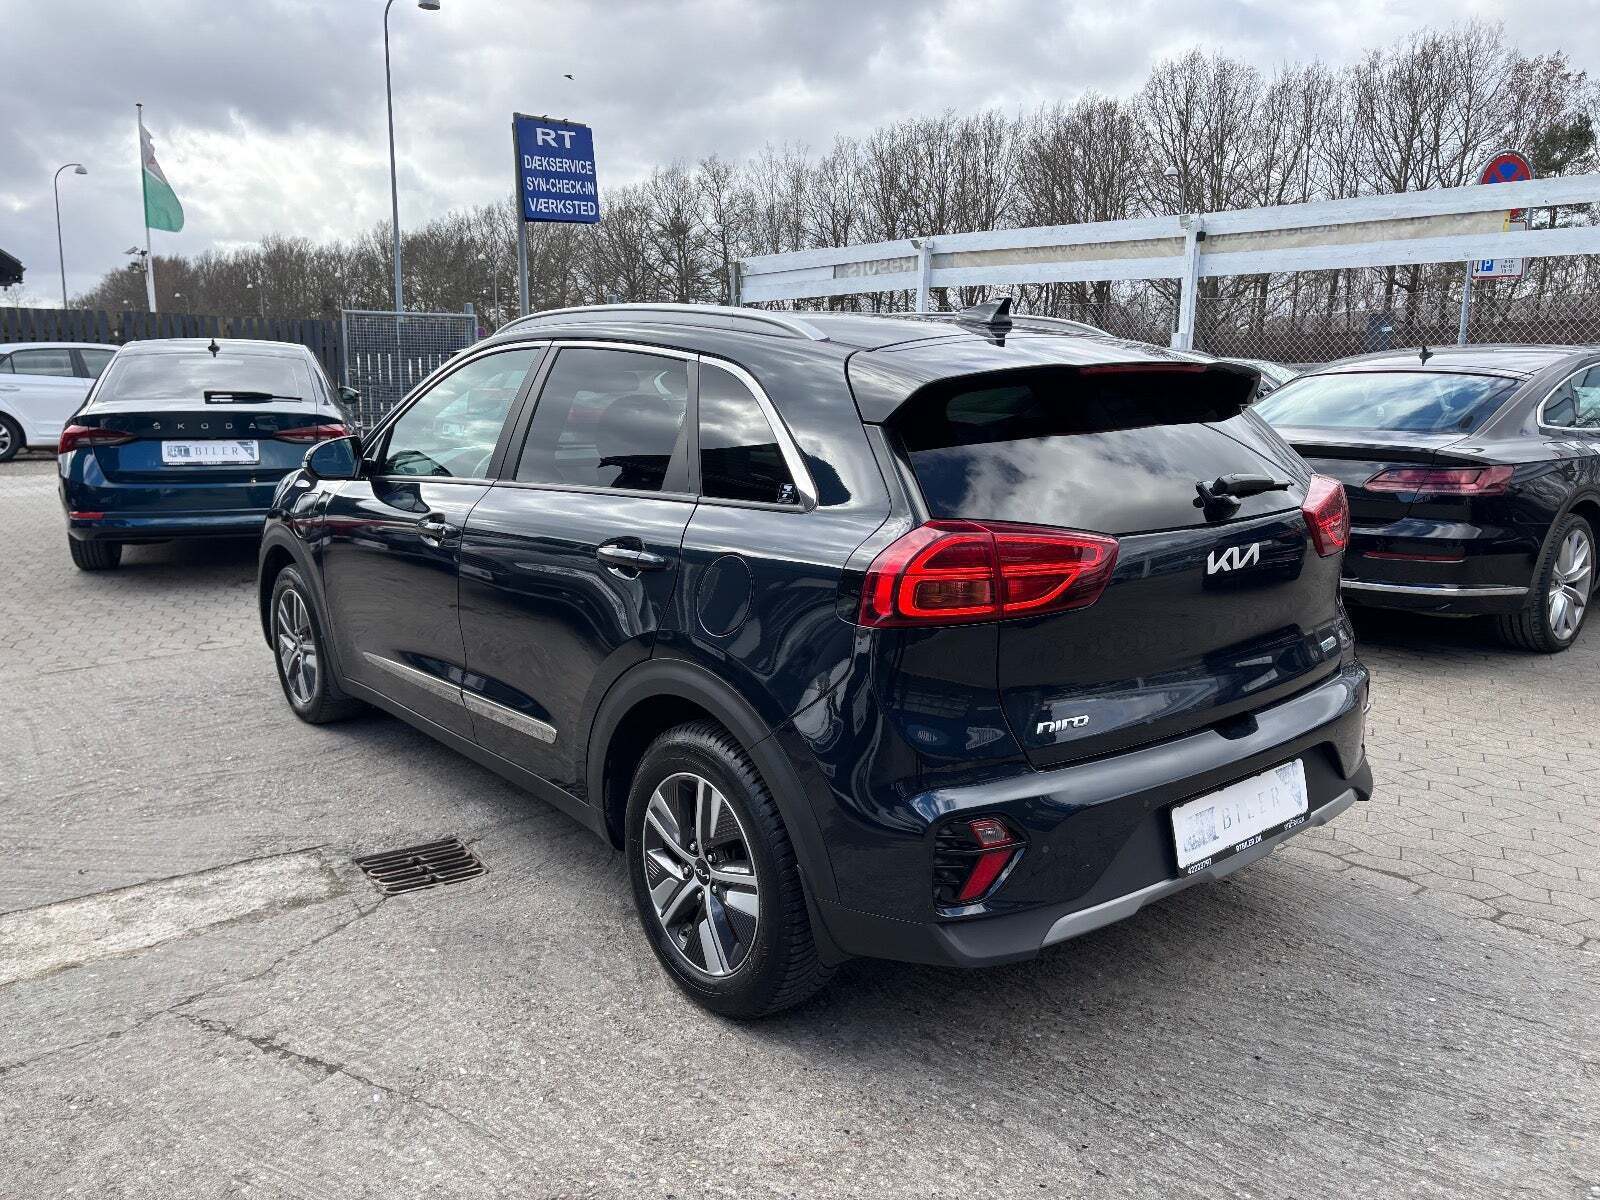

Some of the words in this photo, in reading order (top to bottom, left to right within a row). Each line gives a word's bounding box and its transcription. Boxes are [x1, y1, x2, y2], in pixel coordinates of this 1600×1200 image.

[536, 127, 576, 149] RT
[524, 155, 593, 175] DÆKSERVICE
[526, 176, 595, 195] SYN-CHECK-IN
[528, 197, 596, 216] VÆRKSTED
[195, 447, 238, 457] BILER
[1207, 543, 1260, 575] KIA
[1223, 786, 1281, 830] BILER
